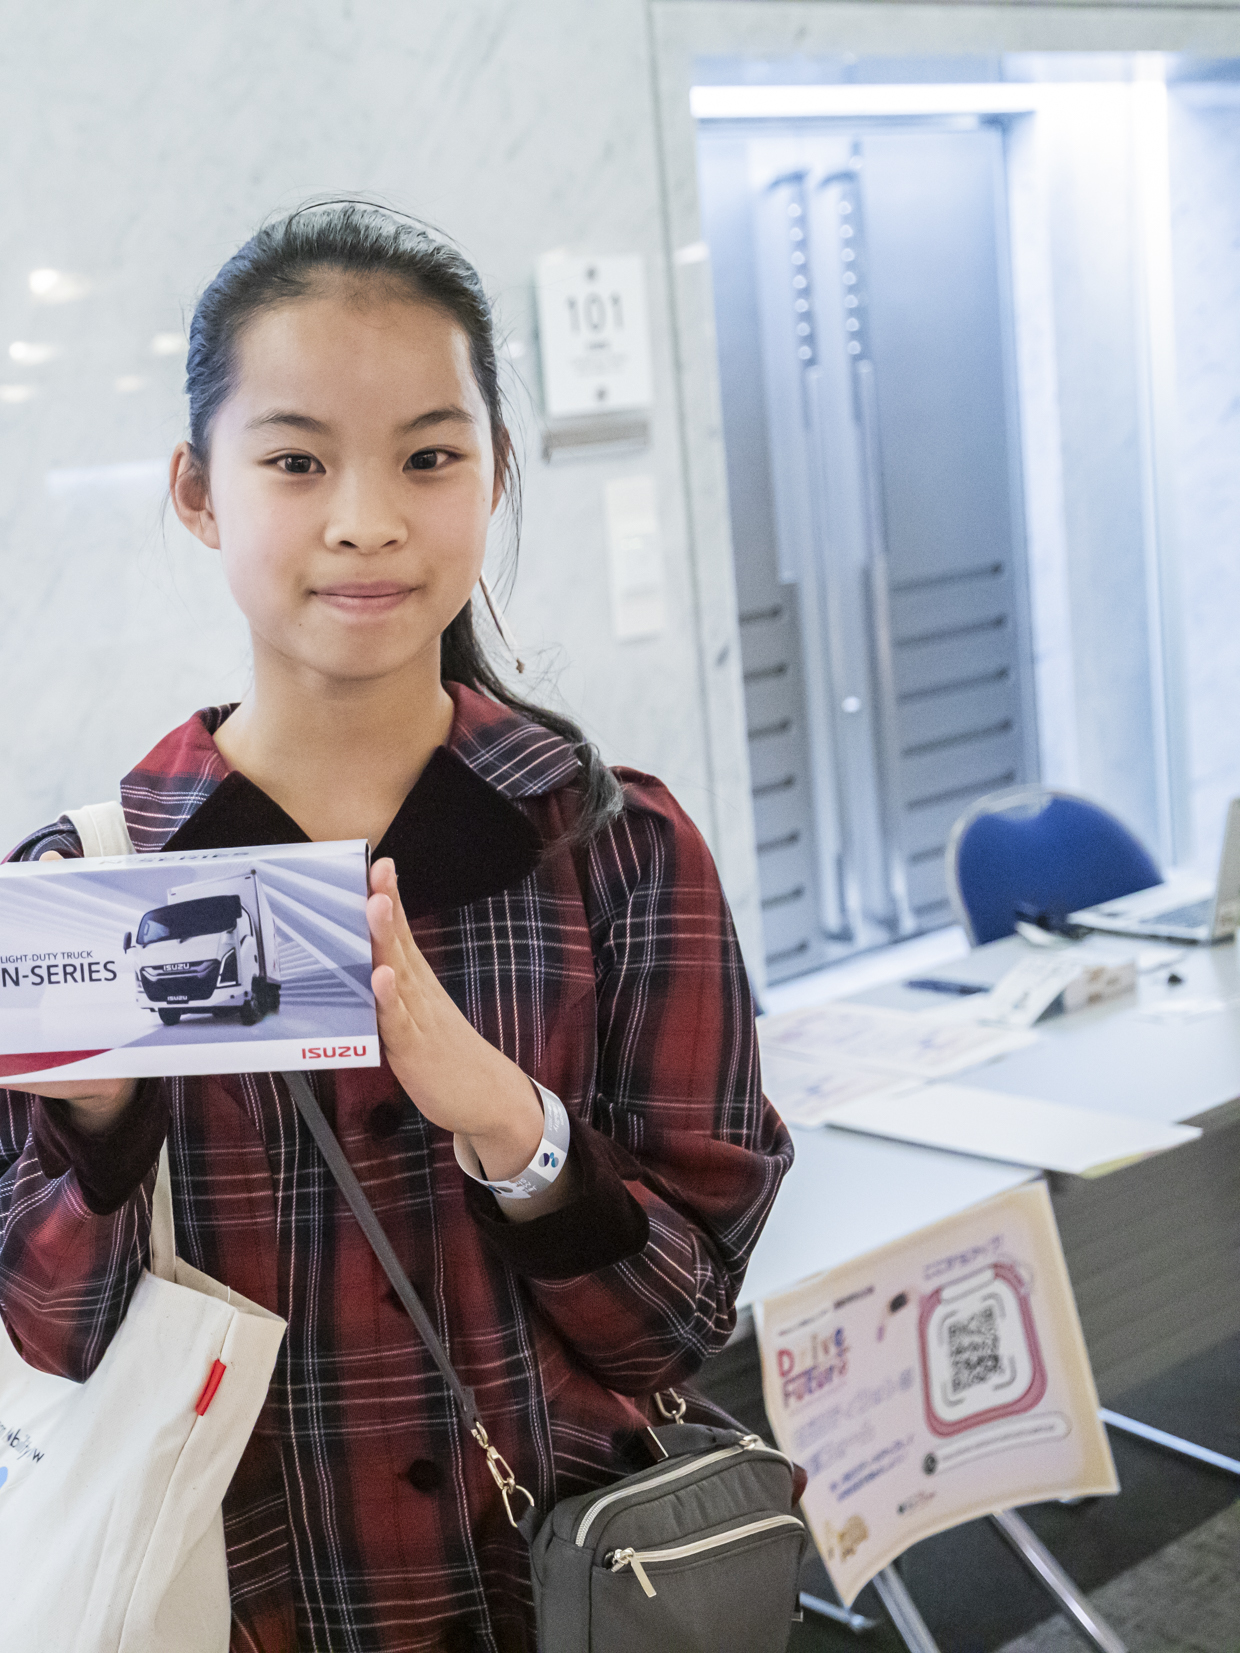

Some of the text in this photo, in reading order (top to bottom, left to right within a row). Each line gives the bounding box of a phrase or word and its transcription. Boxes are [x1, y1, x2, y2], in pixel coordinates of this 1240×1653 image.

[567, 293, 625, 334] 101
[0, 950, 94, 964] LIGHT-DUTY TRUCK
[1, 960, 118, 988] N-SERIES
[163, 962, 190, 972] ISUZU
[301, 1045, 367, 1060] ISUZU
